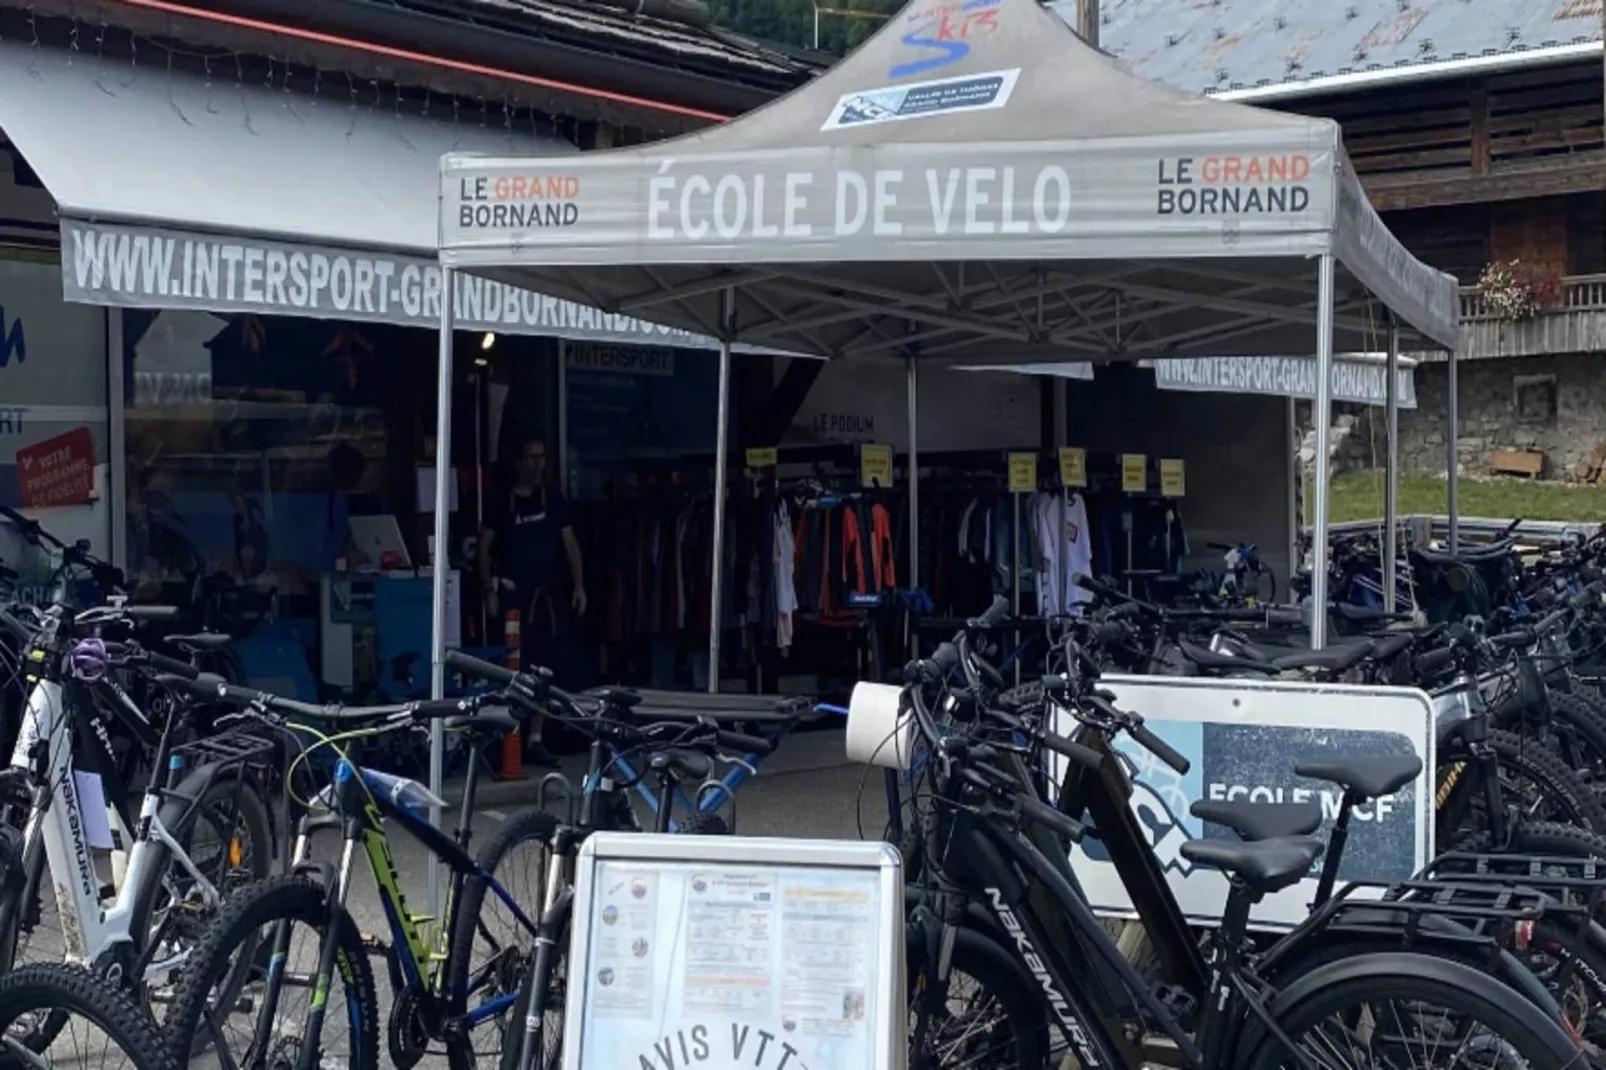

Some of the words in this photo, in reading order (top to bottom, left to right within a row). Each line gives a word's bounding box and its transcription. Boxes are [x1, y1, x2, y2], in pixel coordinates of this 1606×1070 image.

[1158, 159, 1193, 184] LE
[1202, 155, 1310, 183] GRAND
[460, 177, 488, 200] LE
[494, 175, 580, 199] GRAND
[649, 159, 812, 239] ÉCOLE
[835, 170, 903, 236] DE
[926, 165, 1071, 234] VELO
[1157, 187, 1309, 214] BORNAND
[459, 203, 579, 227] BORNAND
[575, 344, 671, 370] INTERSPORT
[813, 414, 828, 432] LE
[830, 414, 875, 434] PODIUM
[731, 1022, 798, 1070] VTT
